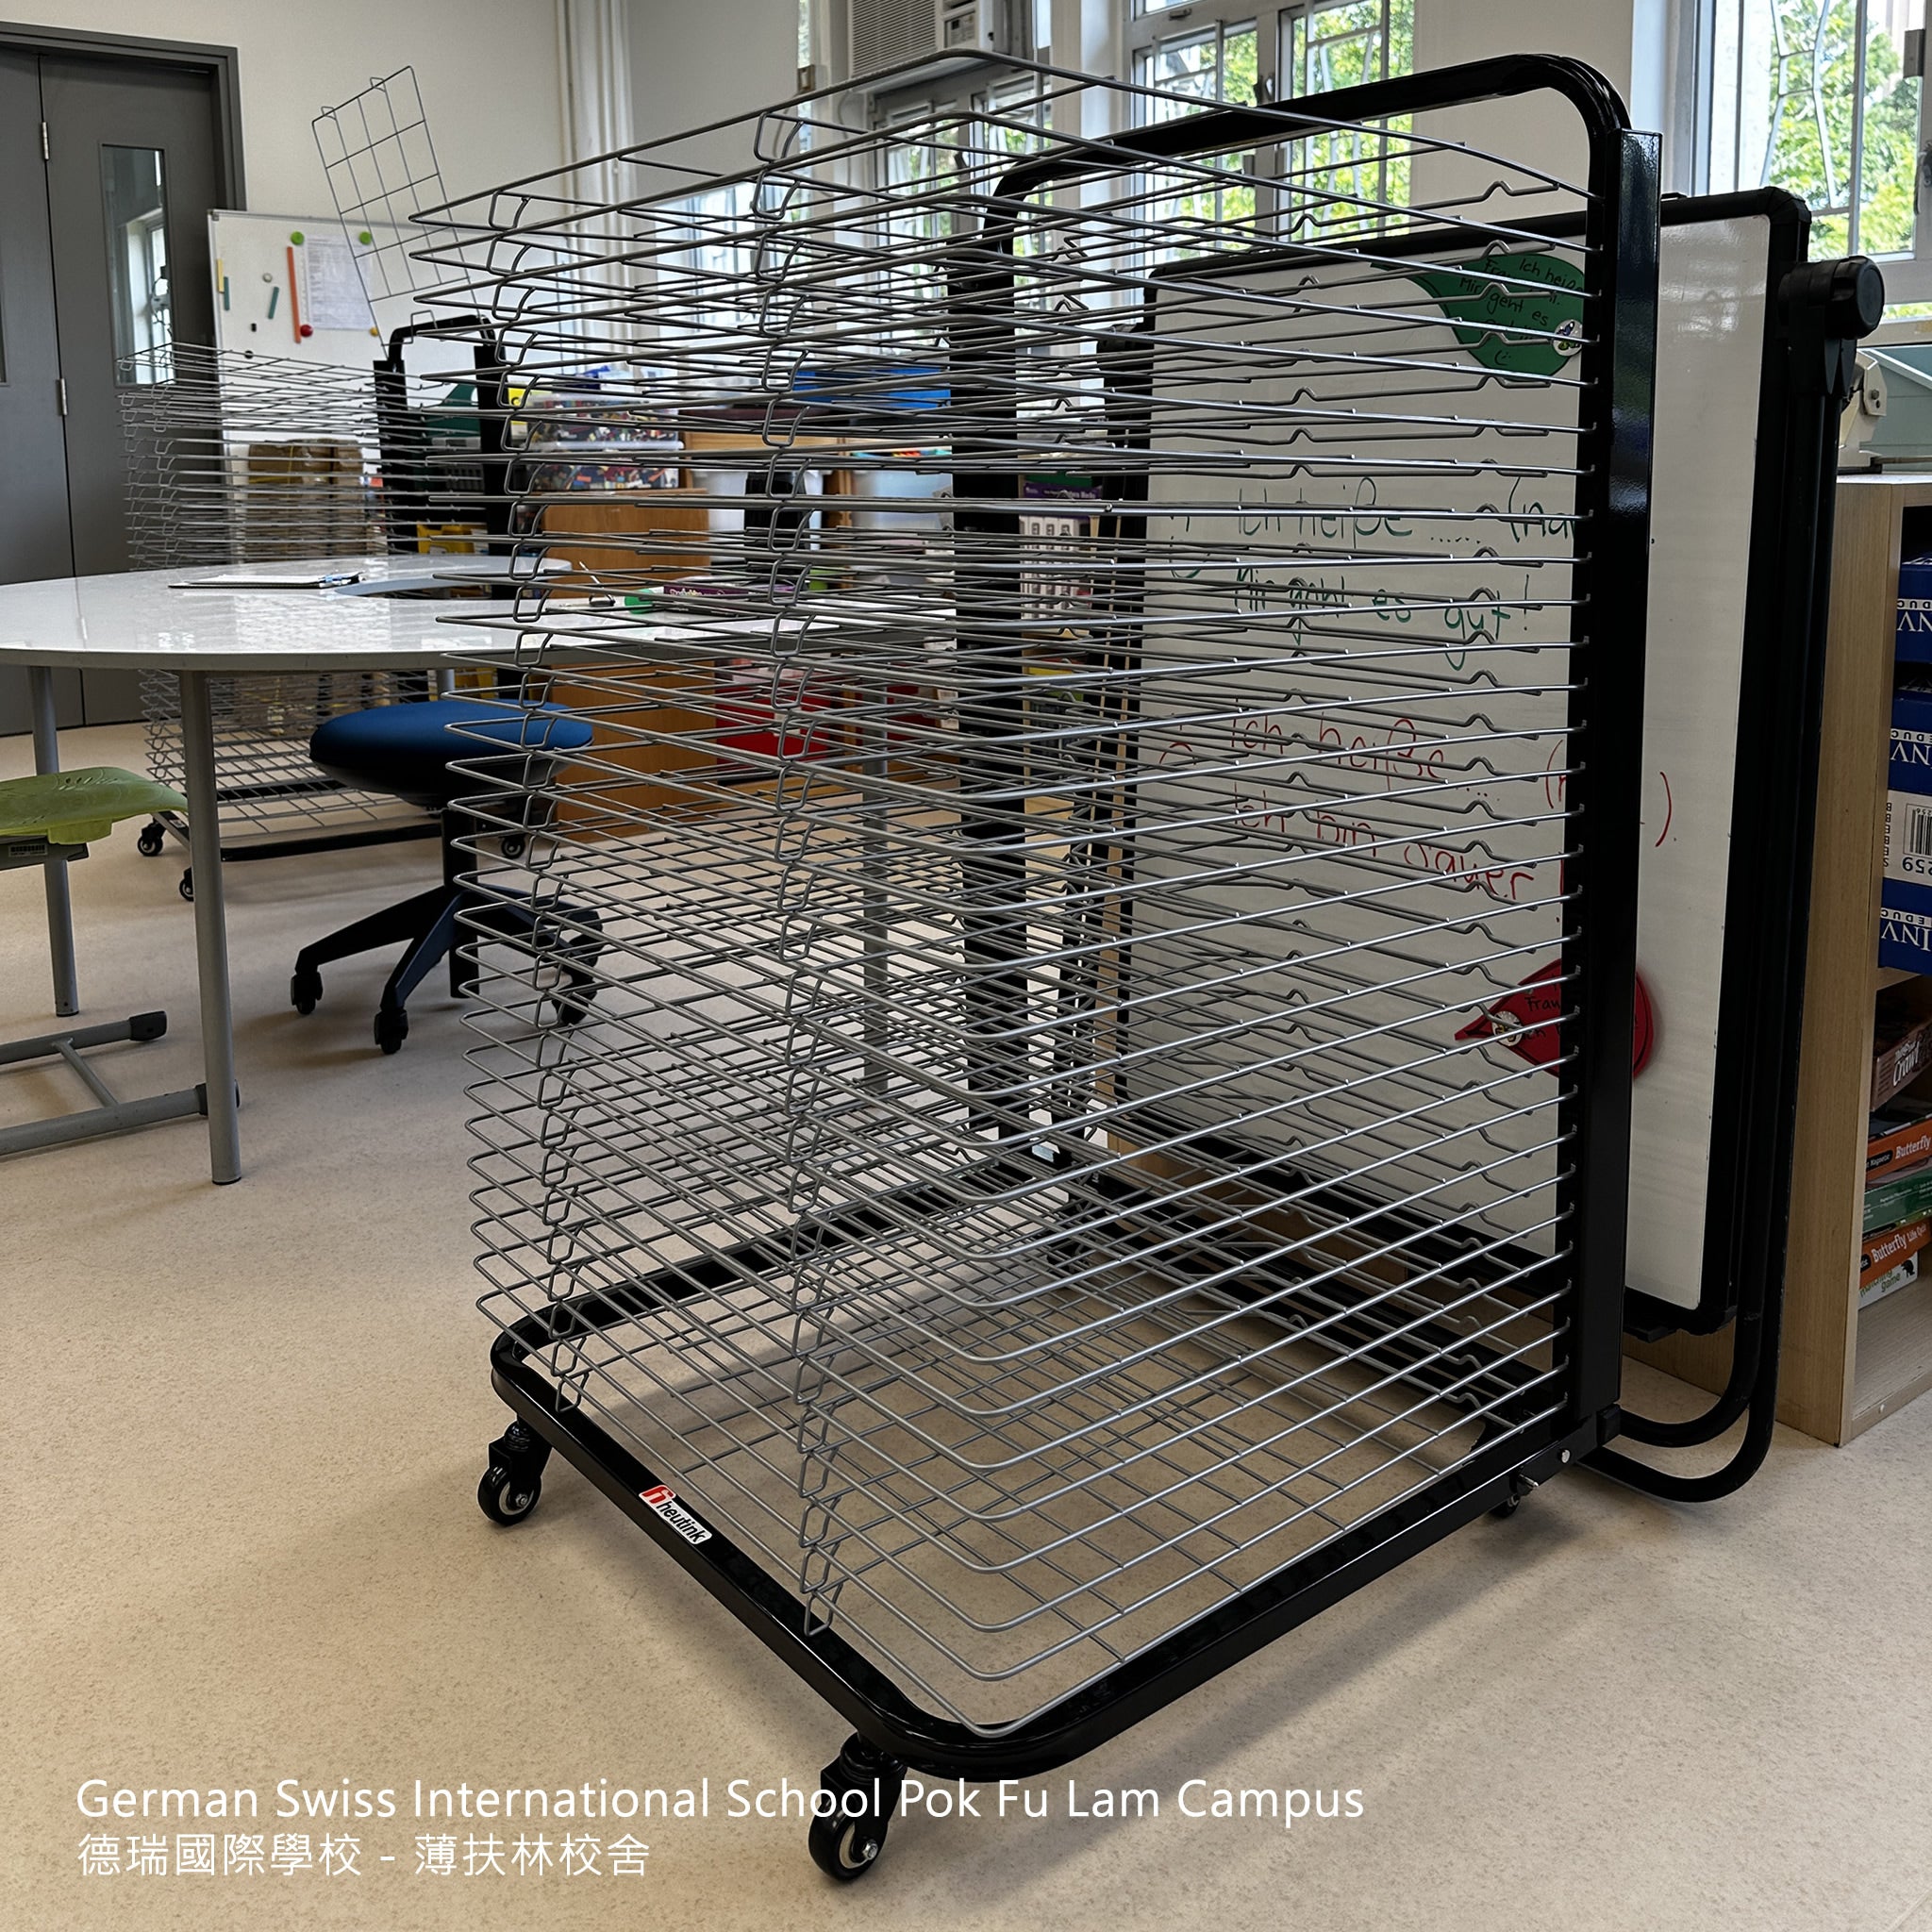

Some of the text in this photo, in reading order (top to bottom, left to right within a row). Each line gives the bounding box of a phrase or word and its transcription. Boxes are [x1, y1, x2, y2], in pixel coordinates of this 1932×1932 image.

[1520, 258, 1541, 276] Ich
[1532, 310, 1549, 326] es
[1891, 730, 1932, 743] DUC
[1890, 741, 1932, 768] NV
[1894, 1135, 1931, 1159] Butterfly
[1871, 1233, 1907, 1263] Butterfly
[656, 1500, 706, 1542] heutink
